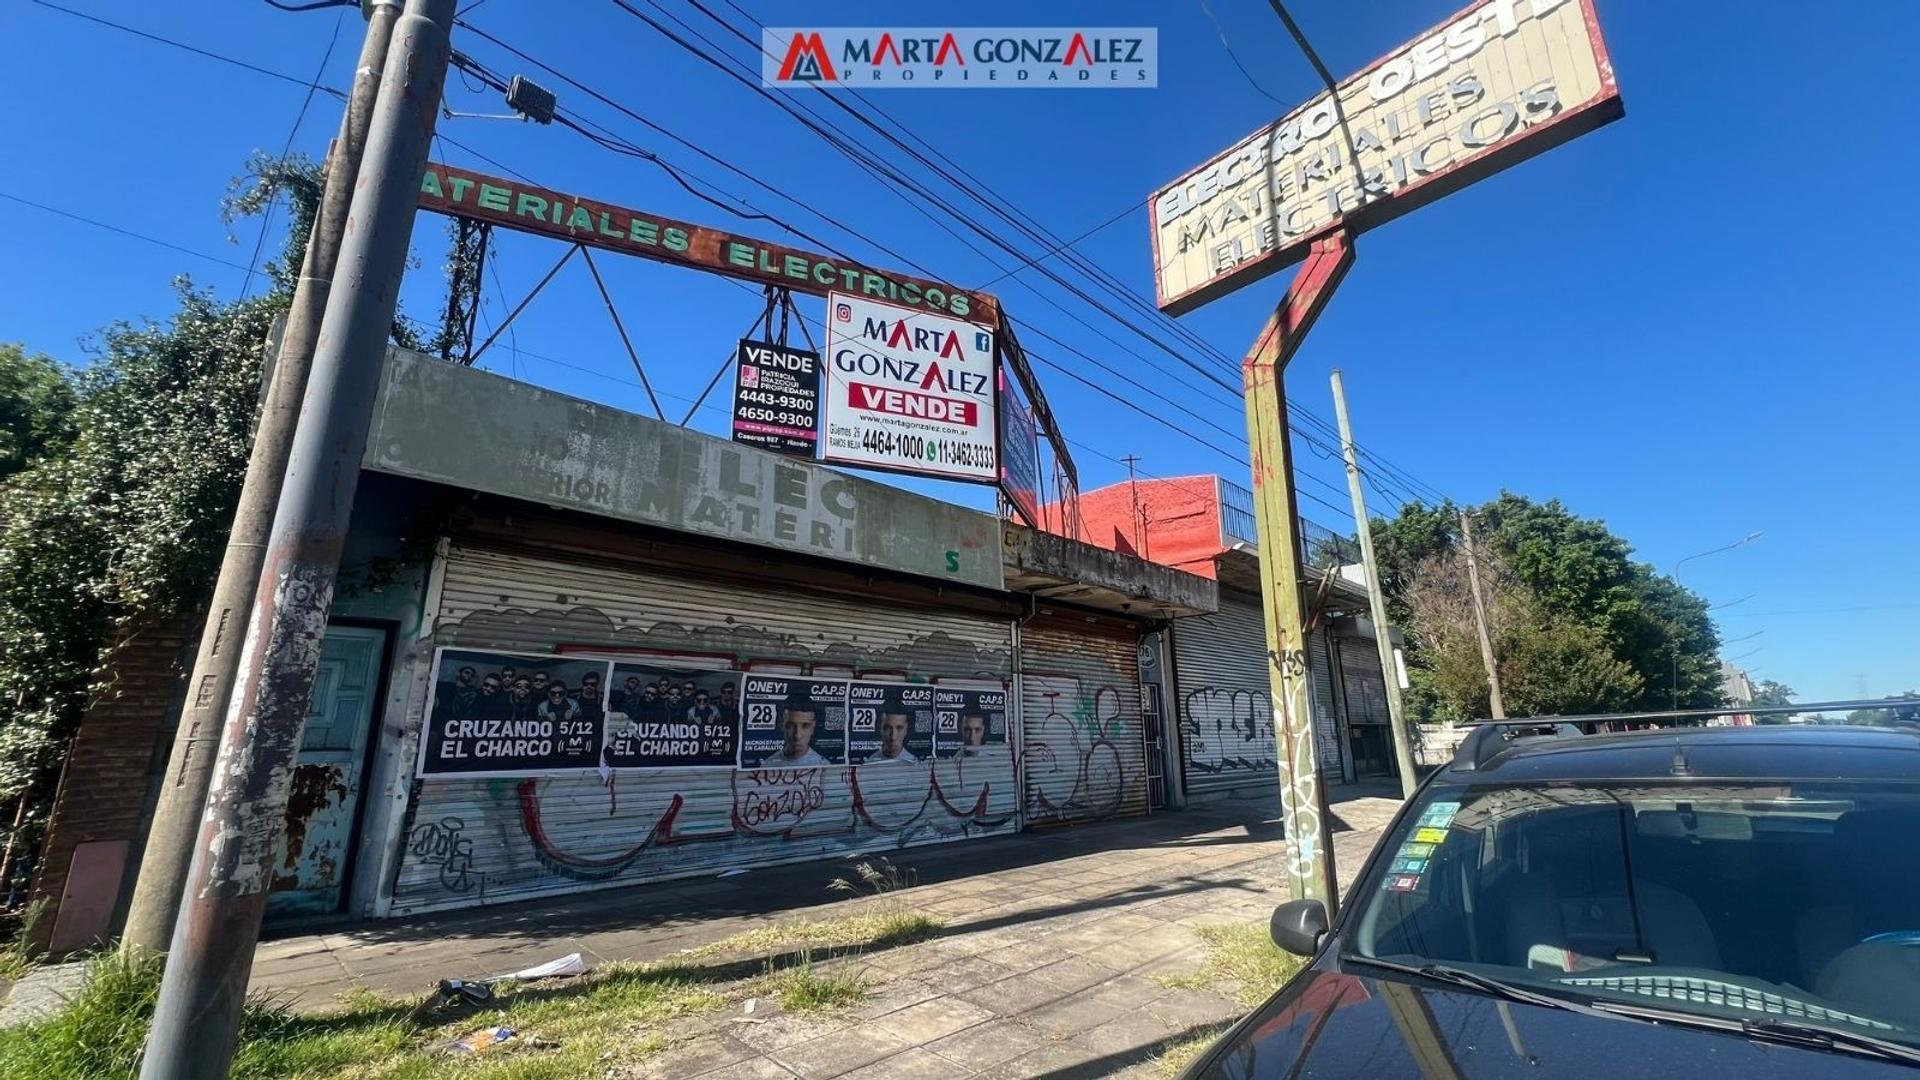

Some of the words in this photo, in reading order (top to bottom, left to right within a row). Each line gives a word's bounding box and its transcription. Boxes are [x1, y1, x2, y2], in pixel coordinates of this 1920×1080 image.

[1160, 101, 1339, 226] ELECTRO
[1177, 72, 1485, 252] MATERIALES
[1210, 78, 1564, 276] ELECTRICOS
[419, 170, 690, 253] ATERIALES
[728, 241, 971, 318] ELECTRICOS
[863, 316, 964, 361] MARTA
[745, 346, 814, 374] VENDE
[761, 369, 796, 382] PATRICIA
[836, 349, 988, 396] GONZALEZ
[739, 389, 814, 412] 4443-9300
[760, 382, 815, 397] PROPIEDADES
[861, 386, 966, 424] VENDE
[738, 406, 813, 428] 4650-9300
[860, 413, 969, 436] www.martagonzalez.com.ar
[863, 428, 923, 460] 4464-1000
[938, 438, 994, 470] 11-3462-3333
[747, 680, 789, 694] ONEY1
[851, 687, 885, 699] ONEY1
[751, 705, 773, 724] 28
[855, 709, 874, 727] 28
[941, 712, 956, 728] 28
[444, 719, 553, 738] CRUZANDO
[559, 721, 593, 736] 5/12
[704, 725, 731, 738] 5/12
[440, 739, 468, 759] EL
[474, 738, 552, 758] CHARCO
[613, 740, 636, 756] EL
[639, 739, 700, 757] CHARCO
